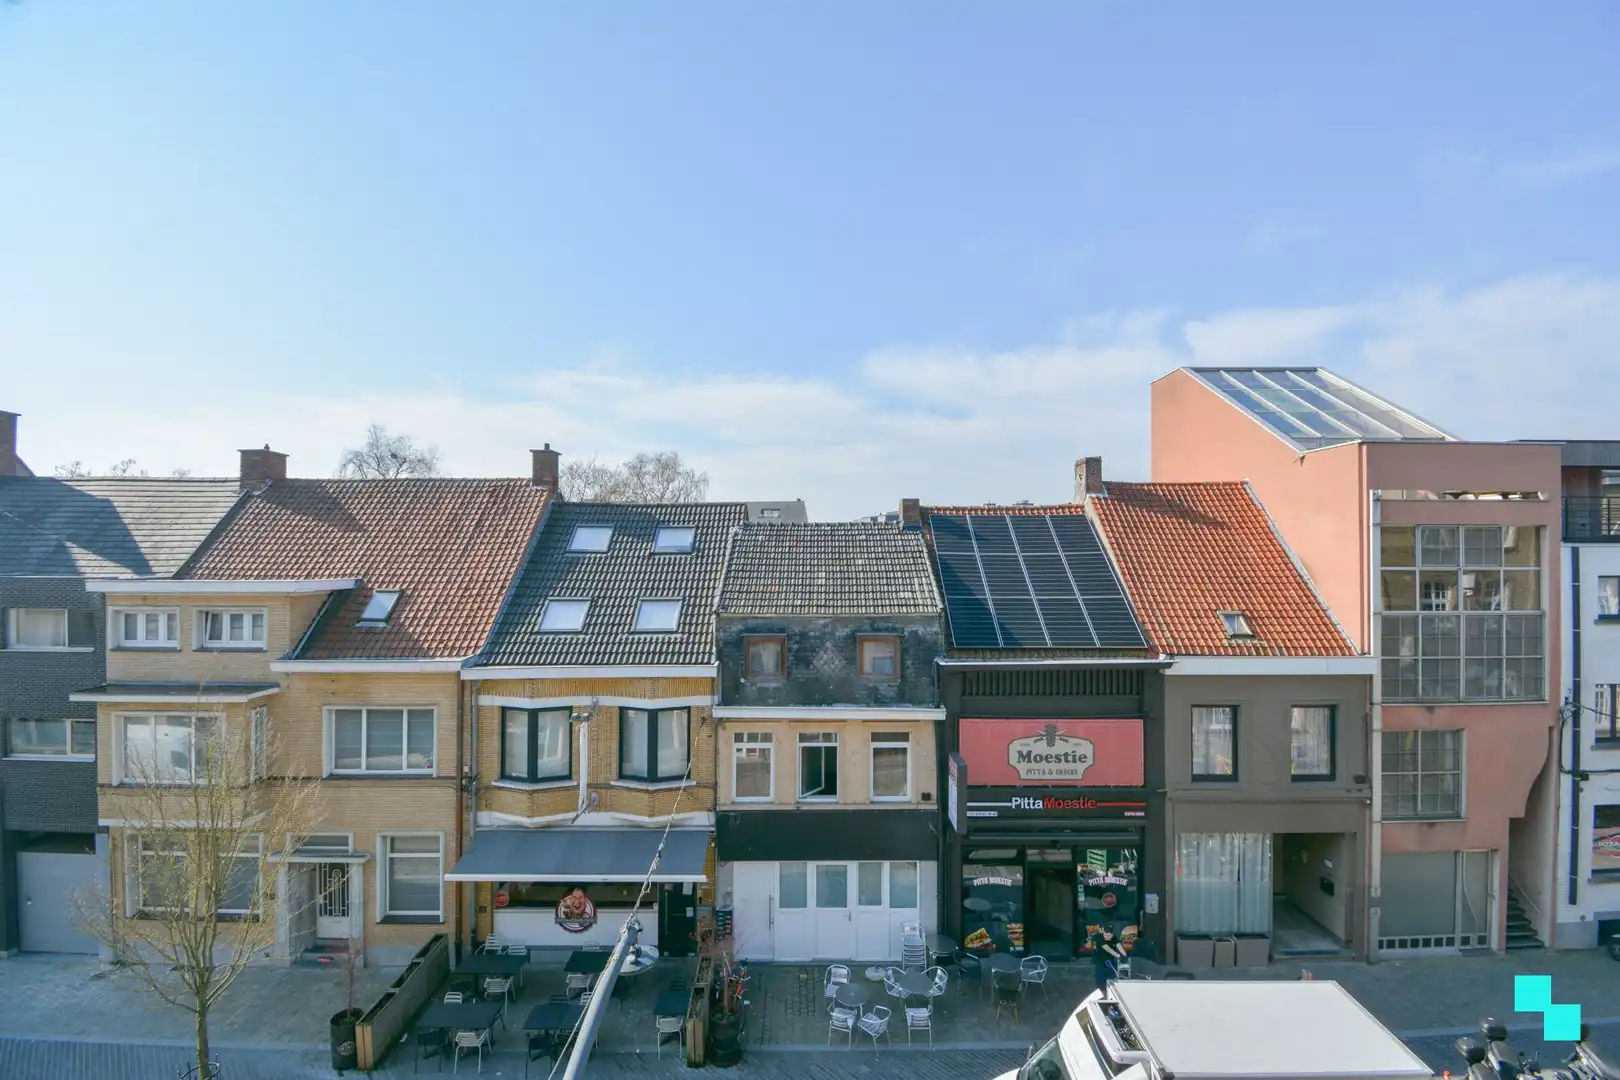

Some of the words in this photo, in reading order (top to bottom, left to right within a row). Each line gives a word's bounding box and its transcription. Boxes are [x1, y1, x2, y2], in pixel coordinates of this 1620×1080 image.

[1017, 750, 1088, 764] Moestie
[1026, 768, 1046, 776] PITTA
[1055, 768, 1079, 776] SNACKS
[973, 877, 989, 886] PITTA
[989, 877, 1012, 886] MOESTIE
[1089, 877, 1104, 886] PITTA
[1105, 876, 1128, 886] MOESTIE
